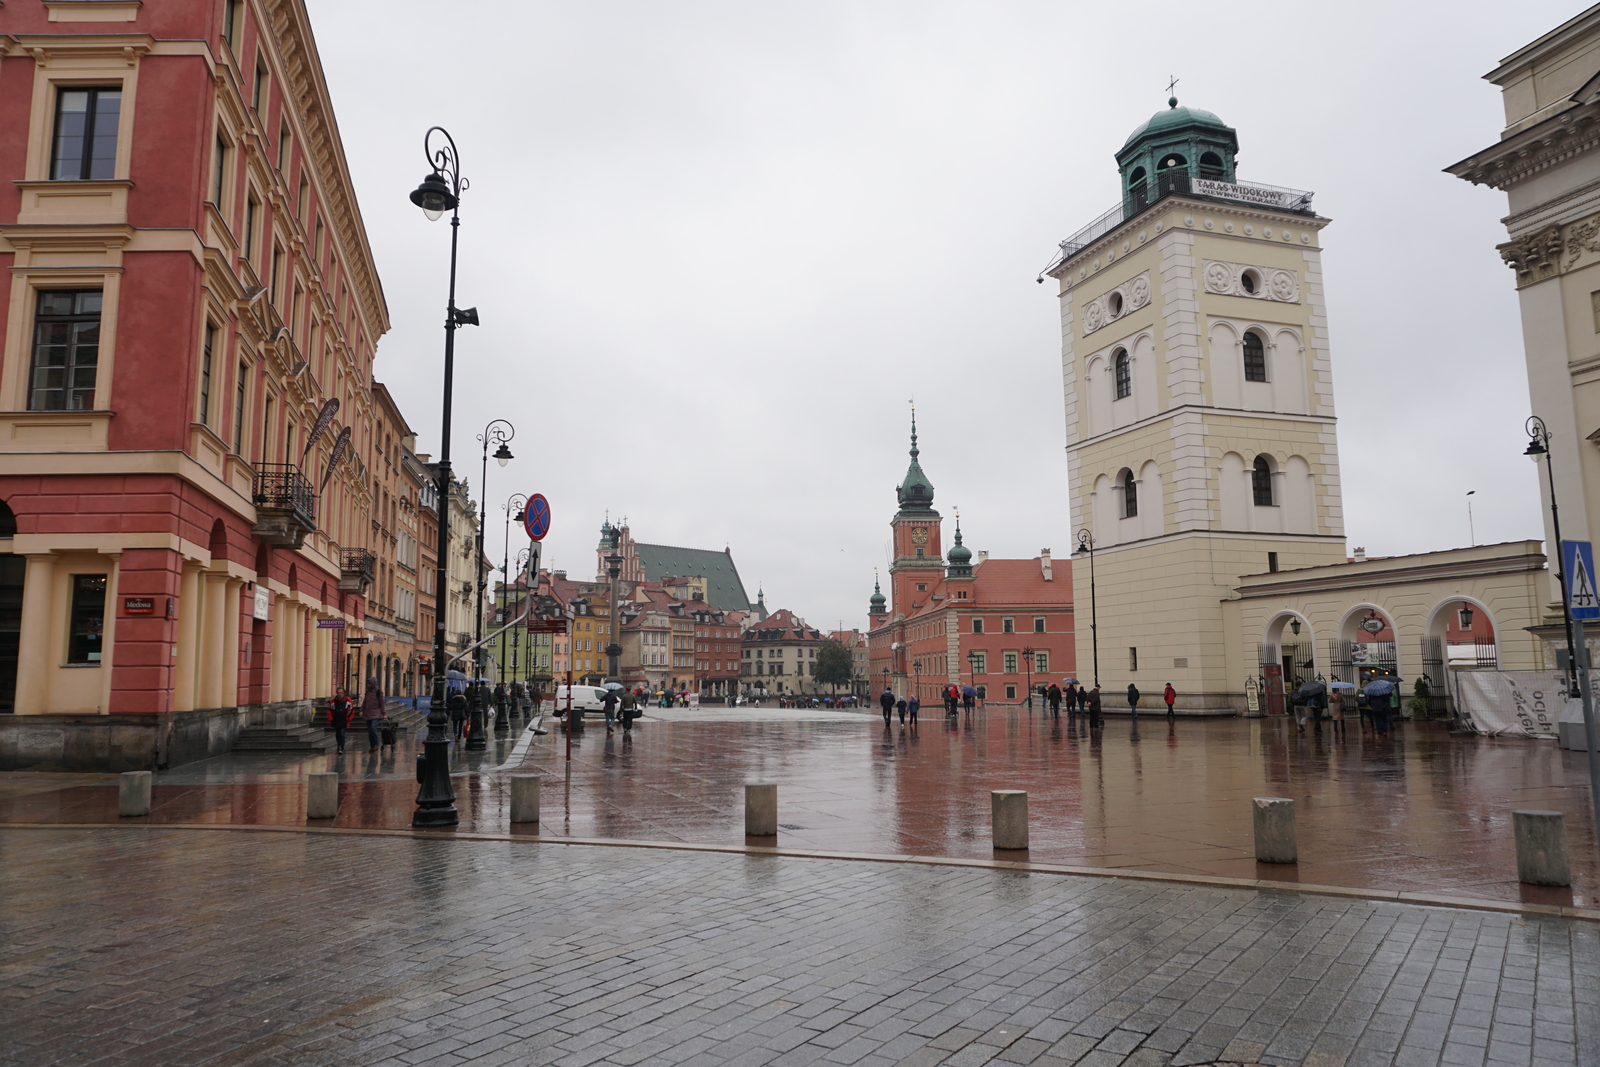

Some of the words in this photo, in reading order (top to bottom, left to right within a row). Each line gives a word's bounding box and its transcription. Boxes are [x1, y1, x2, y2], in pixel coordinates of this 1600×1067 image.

[1196, 180, 1229, 192] TARAS
[1230, 185, 1283, 201] WIDOKOWY
[1202, 188, 1239, 199] VIEWING
[1241, 195, 1281, 205] TERRACE
